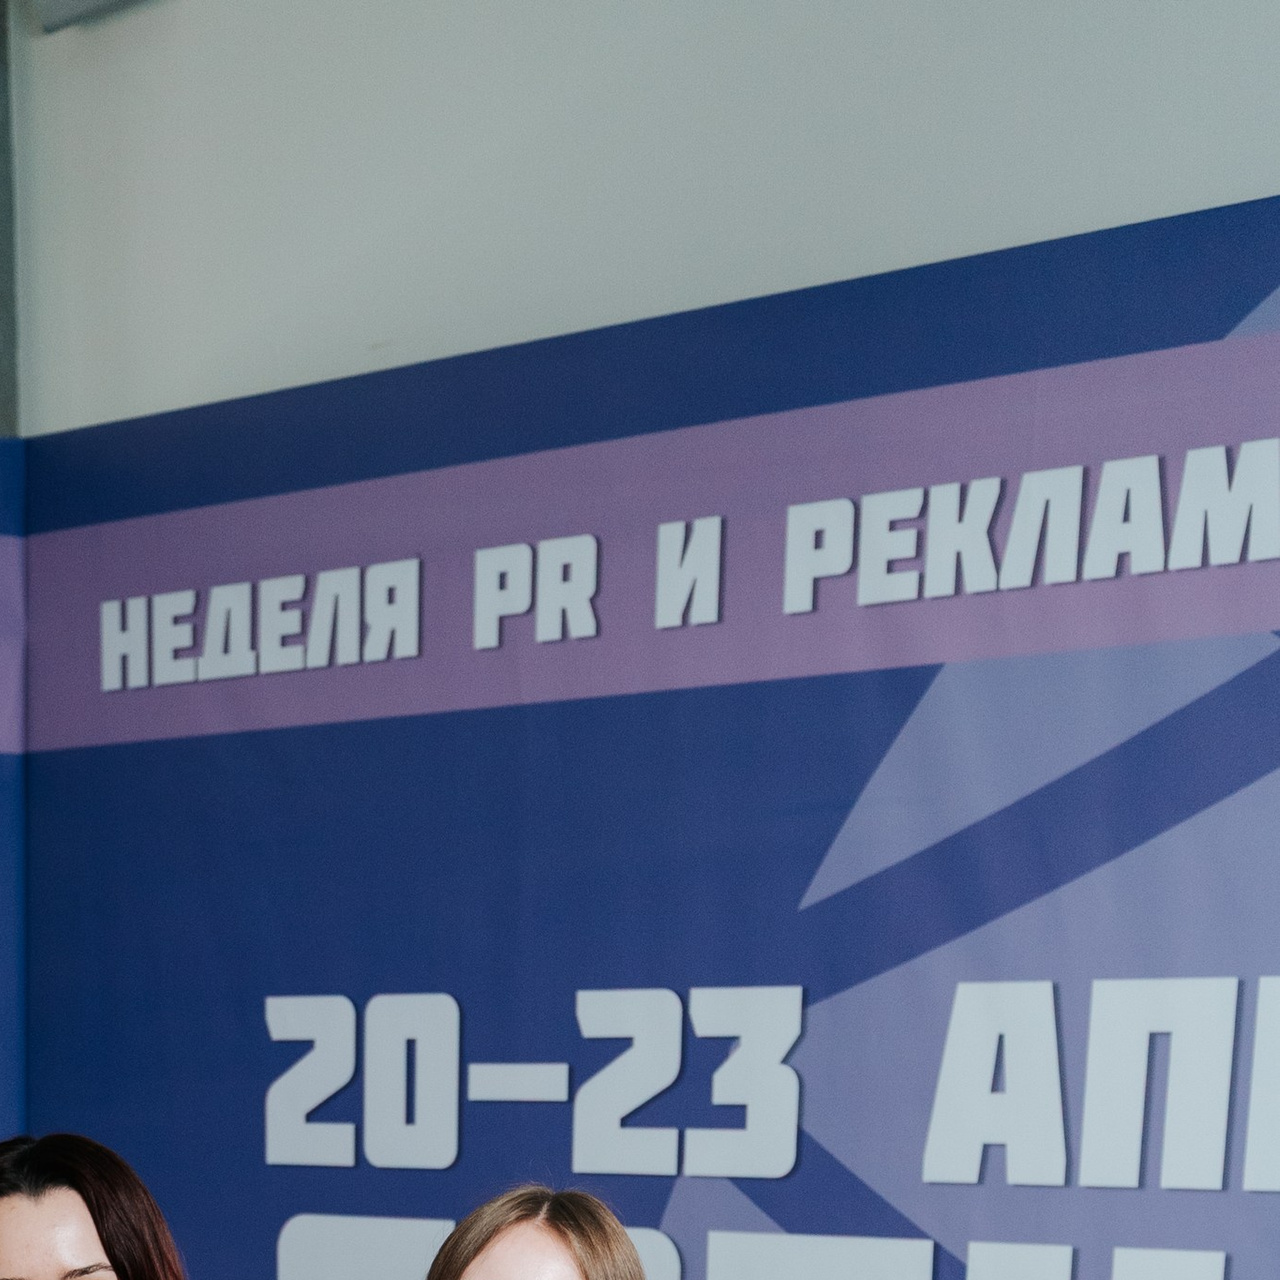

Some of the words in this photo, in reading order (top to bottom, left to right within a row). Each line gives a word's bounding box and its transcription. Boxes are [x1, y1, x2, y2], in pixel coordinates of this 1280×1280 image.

[102, 558, 420, 690] НЕДЕЛЯ
[474, 534, 598, 649] PR
[655, 516, 722, 629] И
[783, 437, 1280, 614] РЕКЛАМ
[922, 976, 1280, 1192] АП
